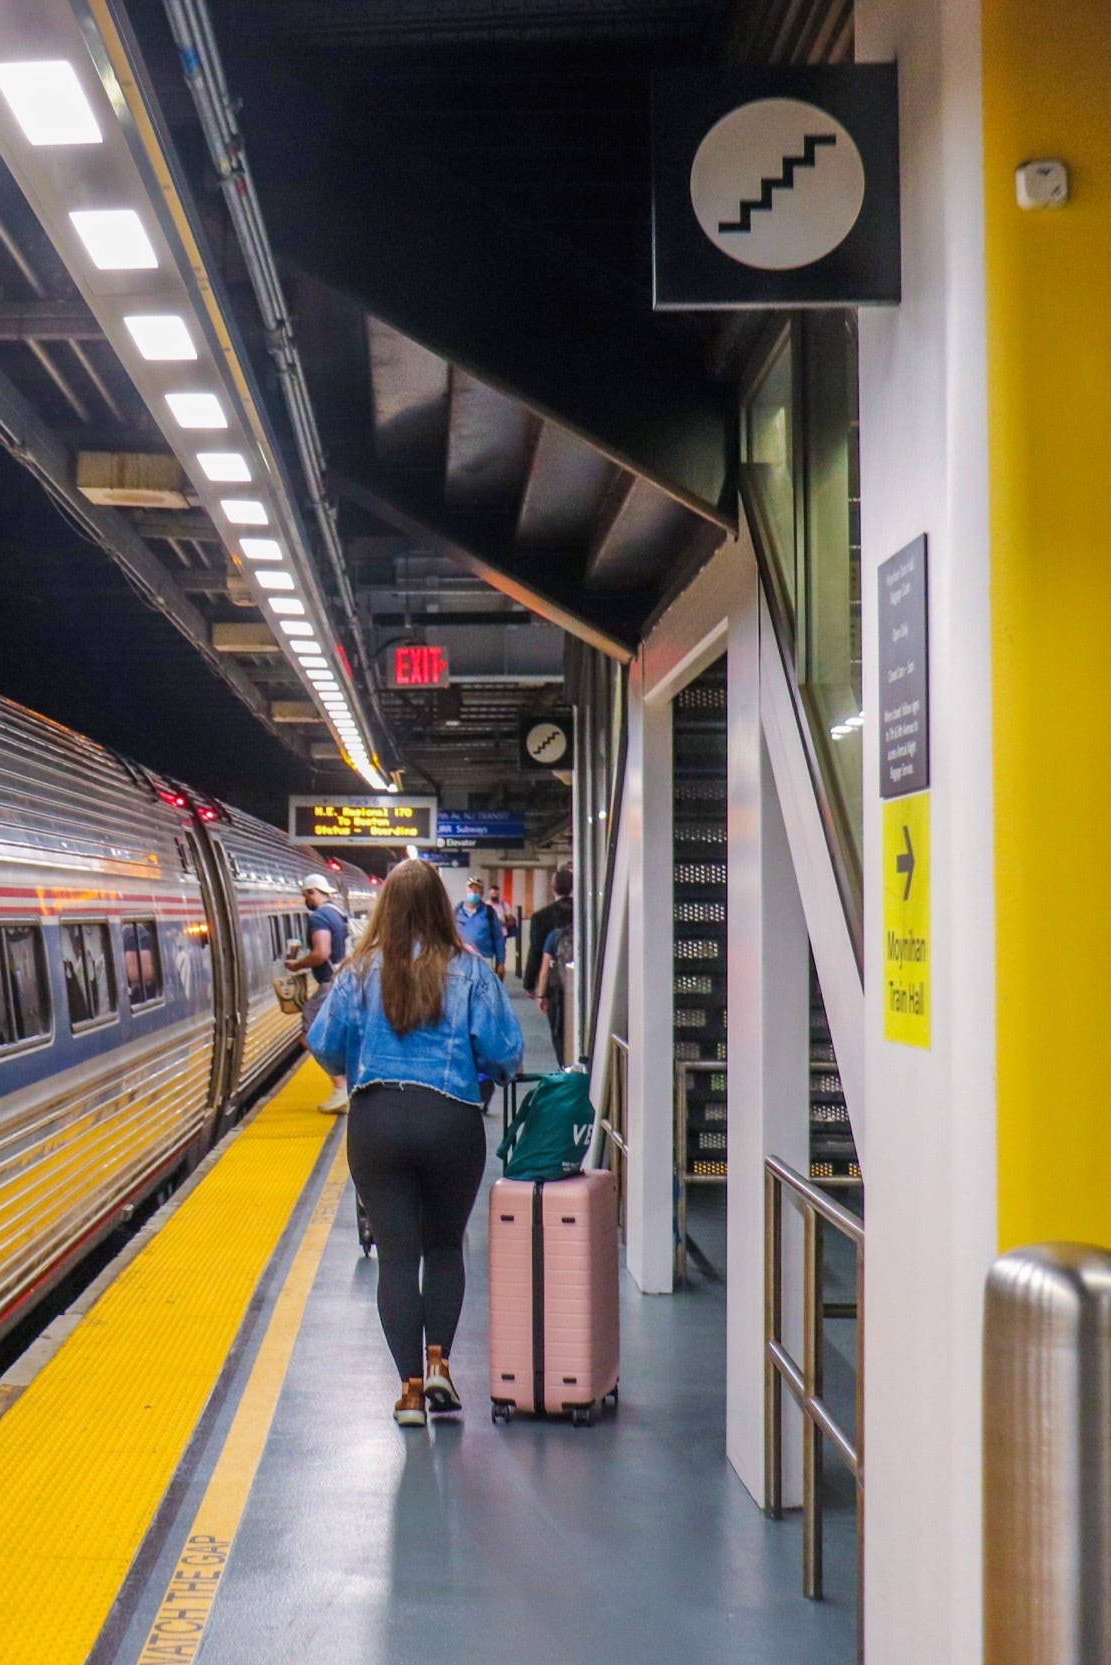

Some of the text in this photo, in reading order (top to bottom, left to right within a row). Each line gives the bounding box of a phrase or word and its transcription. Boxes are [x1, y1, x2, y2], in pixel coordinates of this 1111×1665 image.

[395, 647, 442, 684] EXIT
[337, 816, 351, 826] To
[456, 825, 488, 835] Subways
[446, 838, 477, 847] Elevator
[887, 930, 926, 969] Moynihan
[889, 980, 924, 1016] Train Hall
[180, 1535, 231, 1566] GAP
[165, 1571, 221, 1603] THE
